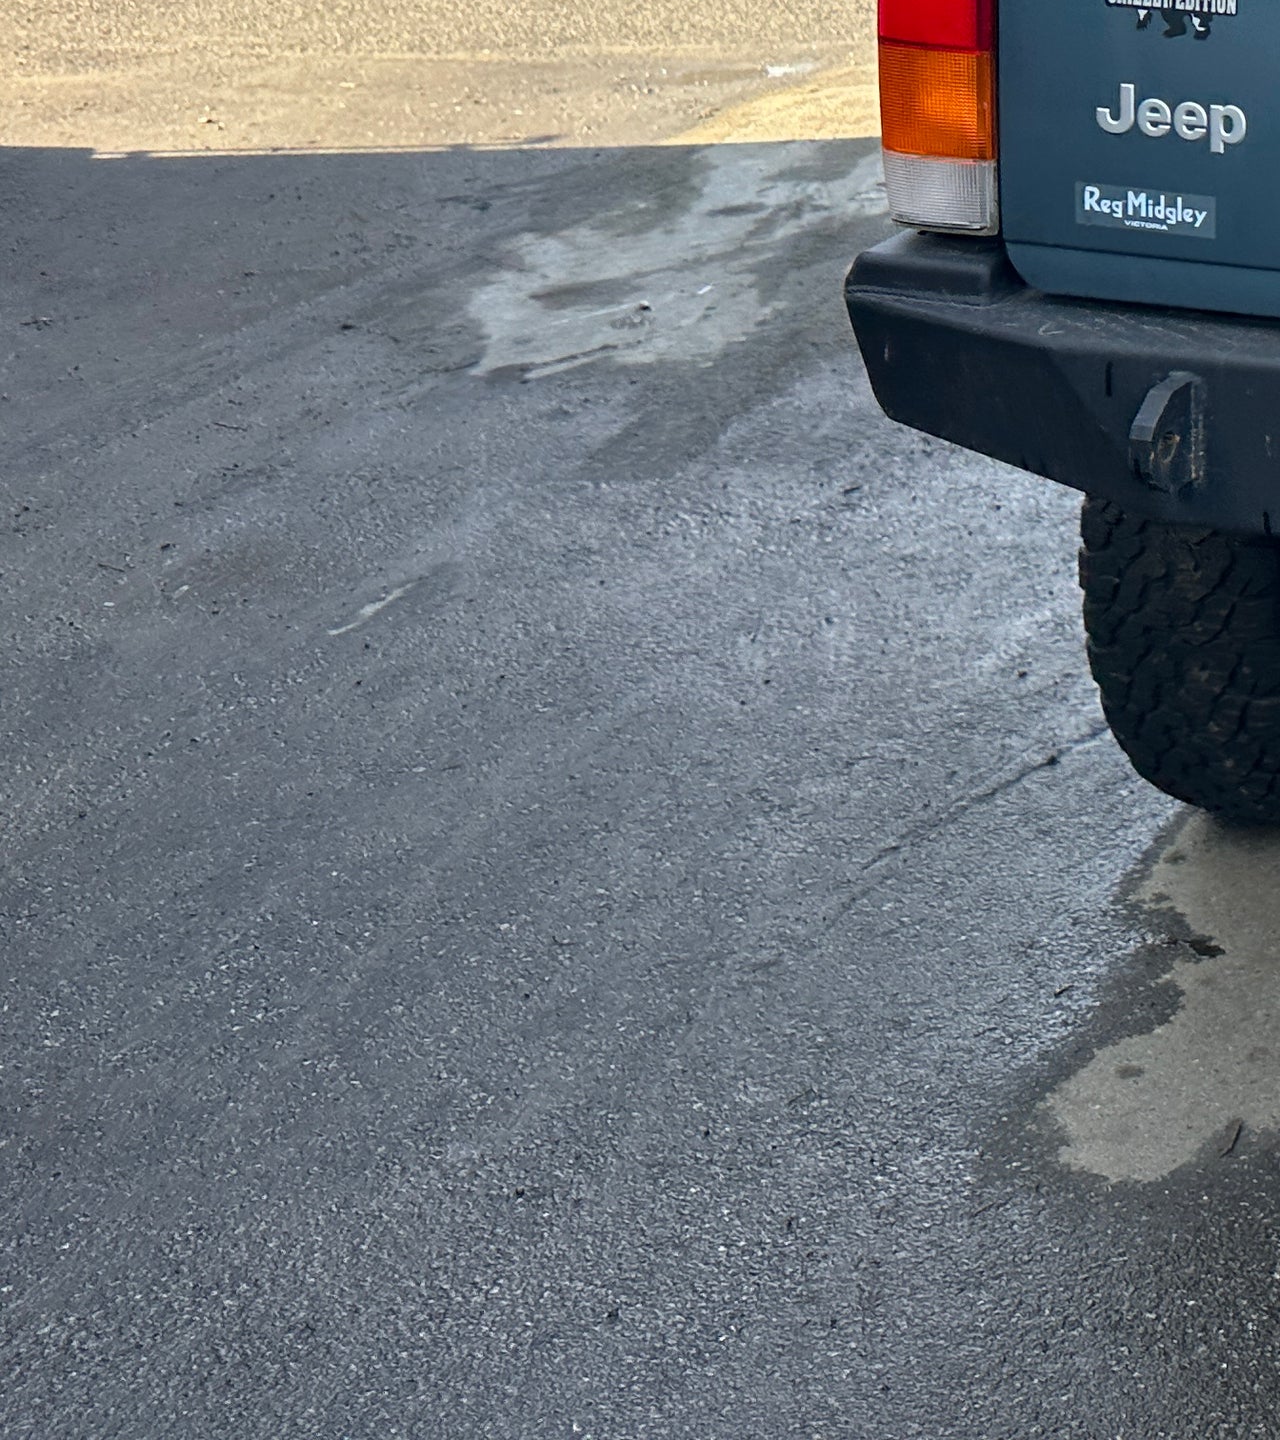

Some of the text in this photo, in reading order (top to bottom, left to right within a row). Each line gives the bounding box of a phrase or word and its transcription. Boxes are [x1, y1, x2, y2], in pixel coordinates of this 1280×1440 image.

[1096, 83, 1247, 153] Jeep
[1084, 185, 1207, 227] Reg Midgley
[1124, 220, 1168, 231] VICTORIA
